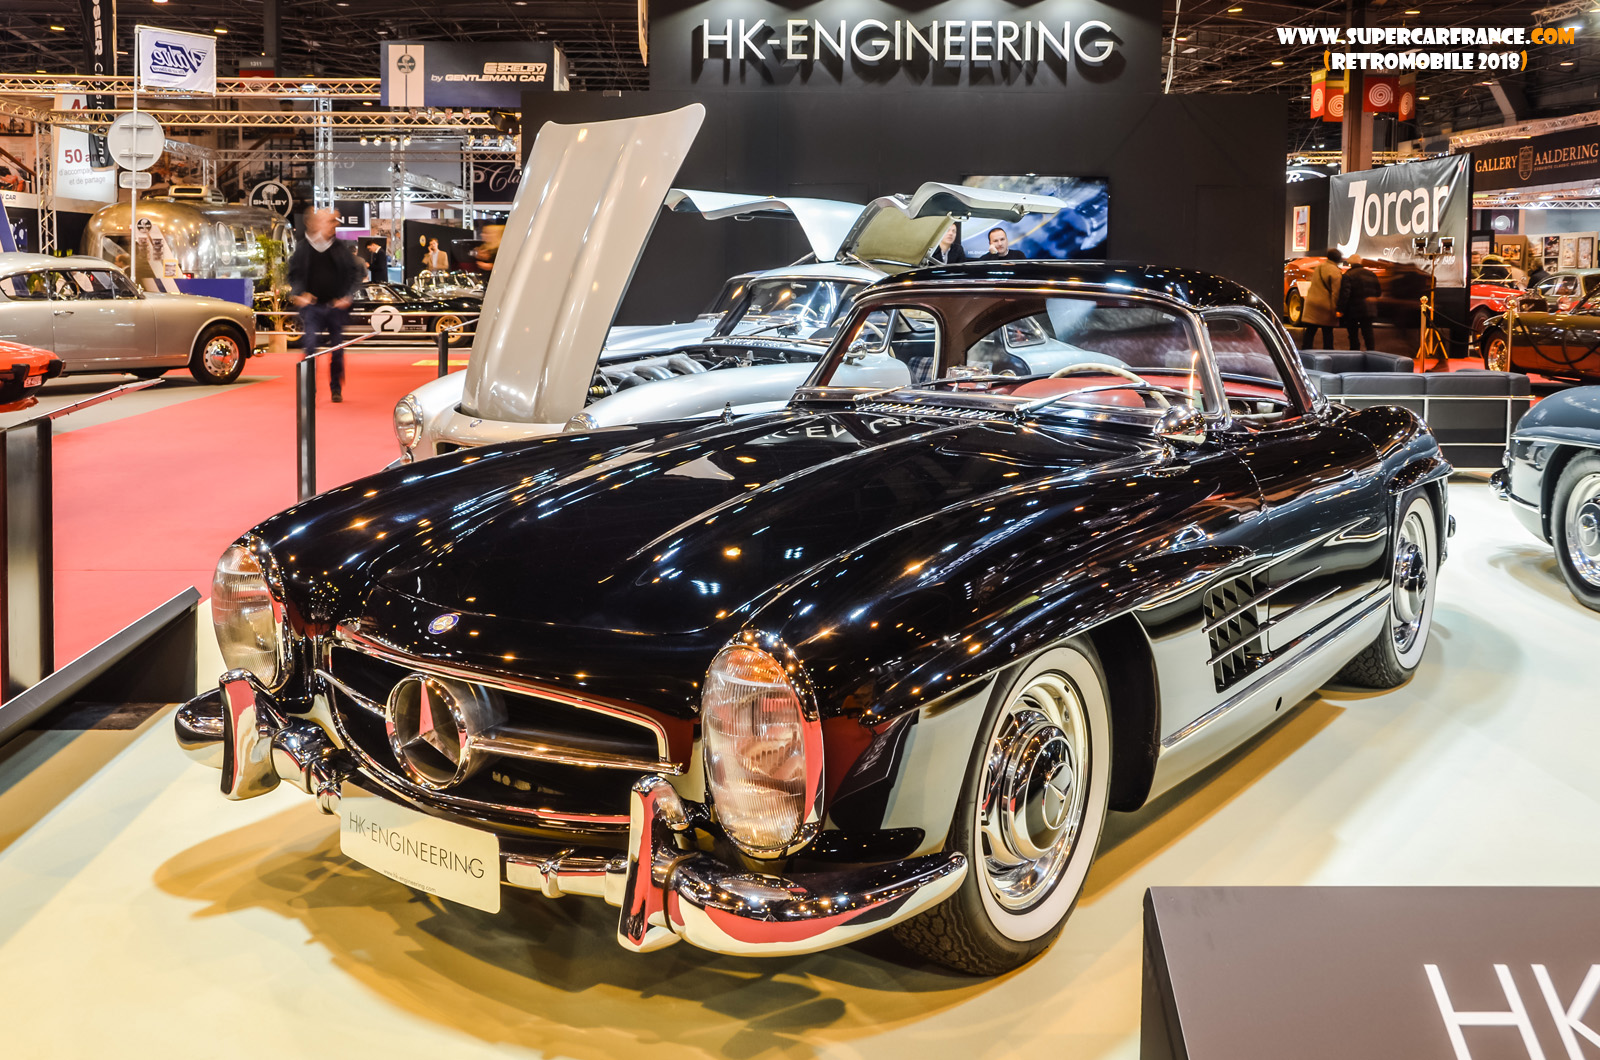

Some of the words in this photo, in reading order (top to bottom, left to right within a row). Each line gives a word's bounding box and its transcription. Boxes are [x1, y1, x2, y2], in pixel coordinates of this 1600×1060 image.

[702, 19, 1114, 64] HK-ENGINEERING
[430, 74, 443, 82] by
[445, 74, 517, 82] GENTLEMAN
[496, 63, 543, 72] SHELBY
[65, 148, 82, 163] 50
[1475, 155, 1518, 173] GALLERY
[1534, 143, 1599, 166] AALDERING
[69, 177, 75, 185] et
[84, 176, 106, 185] partage
[1337, 180, 1450, 258] Jorcar
[380, 310, 394, 332] 2
[349, 811, 485, 879] HK-ENGINEERING
[383, 869, 437, 893] www.hk-engineering.com
